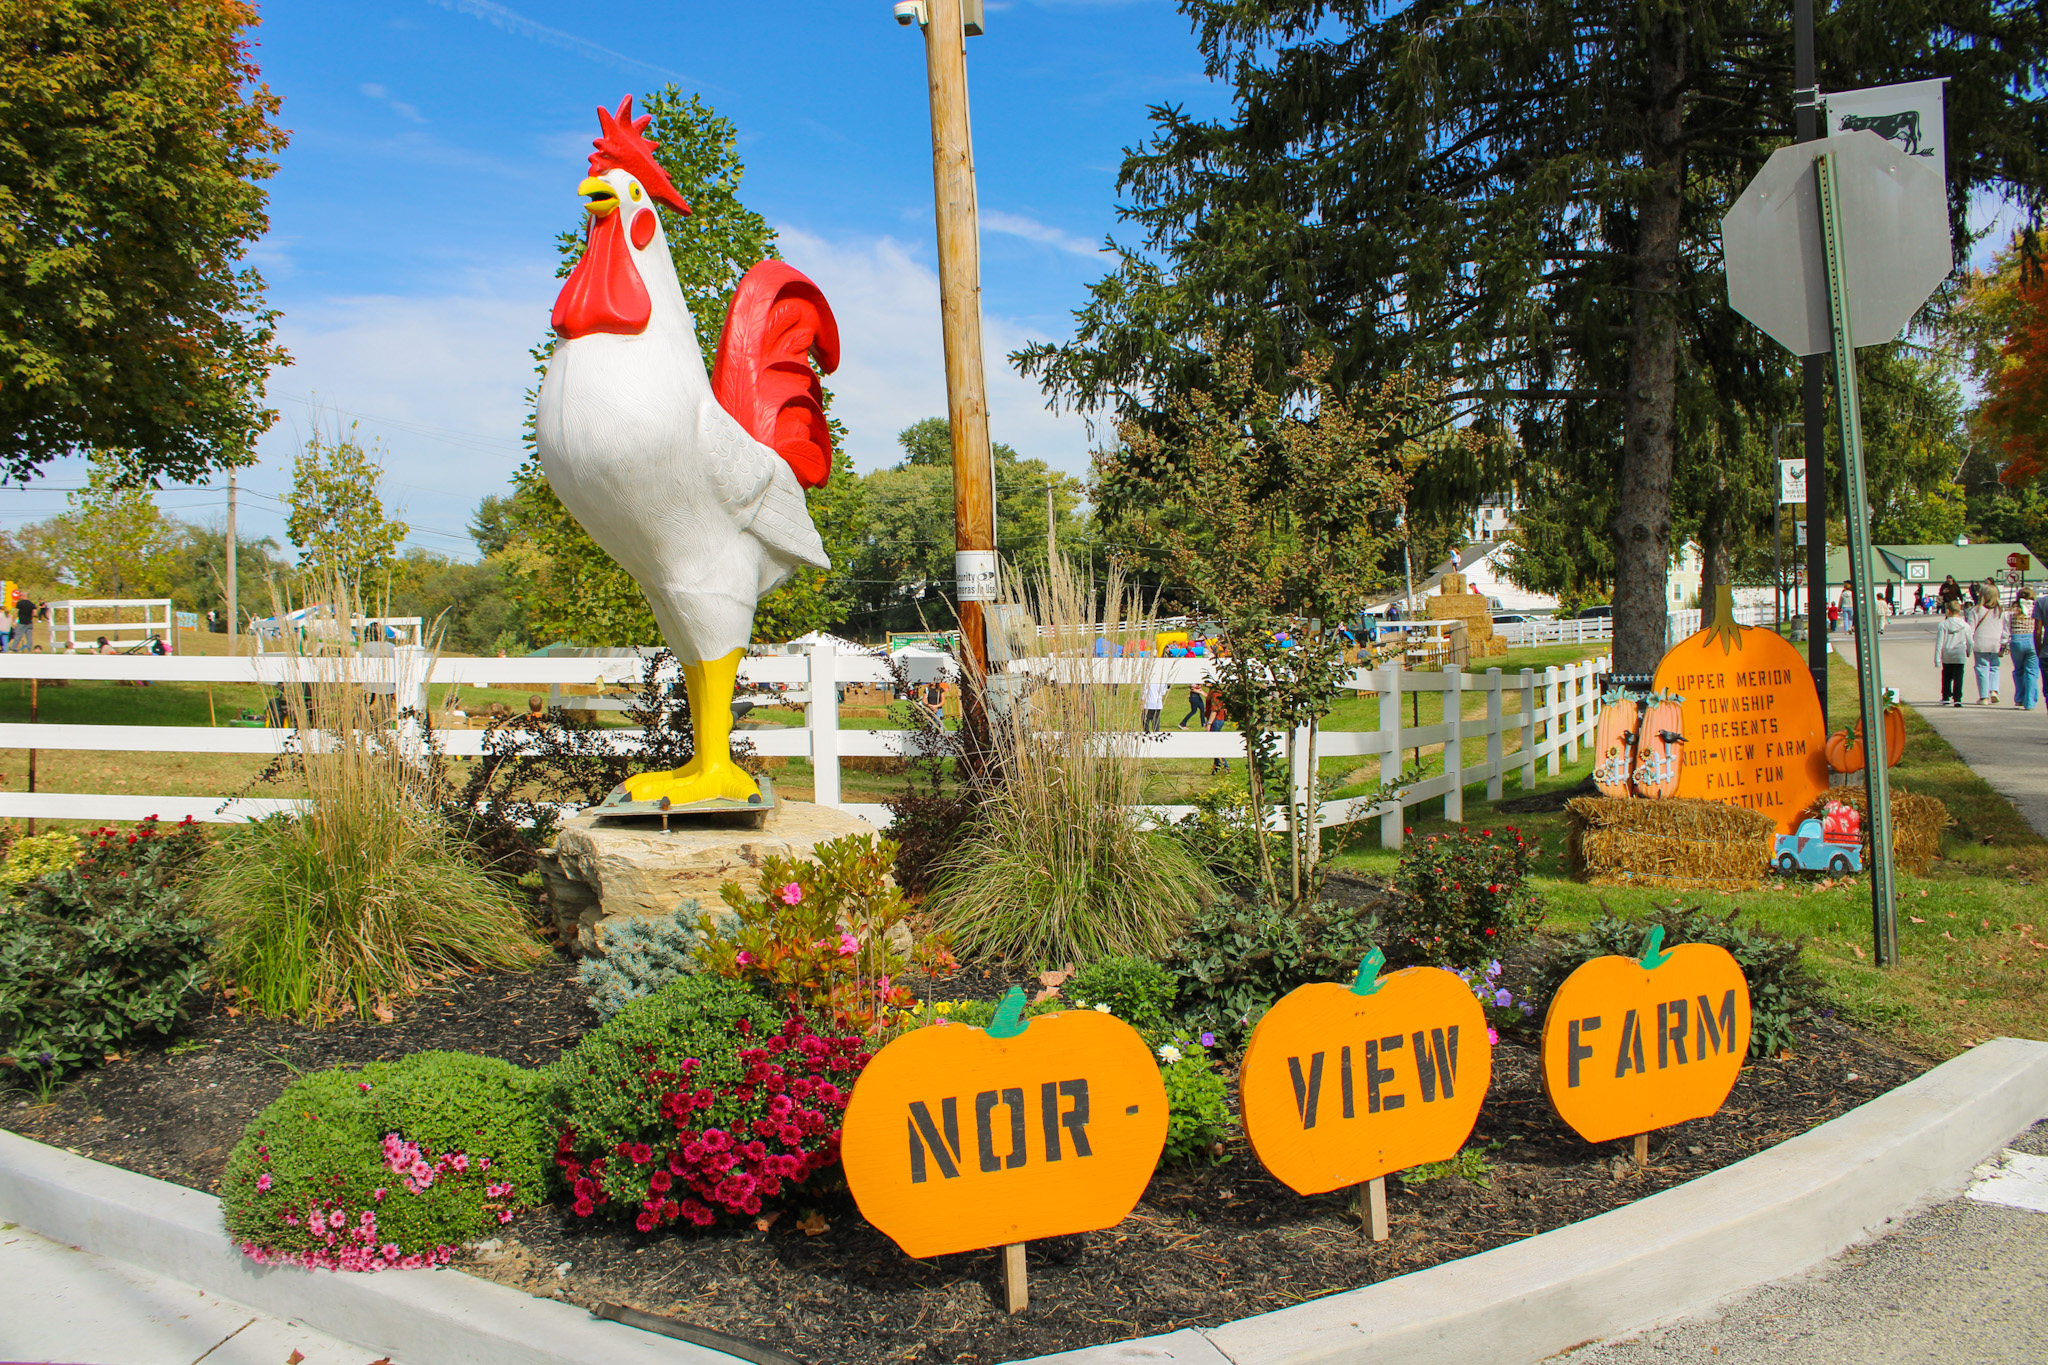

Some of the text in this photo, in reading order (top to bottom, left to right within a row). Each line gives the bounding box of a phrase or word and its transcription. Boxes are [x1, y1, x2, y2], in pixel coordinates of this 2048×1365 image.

[2008, 556, 2016, 564] ST
[957, 572, 975, 583] curity
[986, 584, 995, 594] Use
[1677, 669, 1792, 691] UPPER MERION
[1700, 694, 1774, 715] TOWNSHIP
[1701, 718, 1778, 740] PRESENTS
[1766, 740, 1807, 759] FARM
[1707, 766, 1784, 789] FALL FUN
[1714, 791, 1784, 809] STIVAL
[1568, 989, 1735, 1088] FARM
[1288, 1025, 1459, 1130] VIEW
